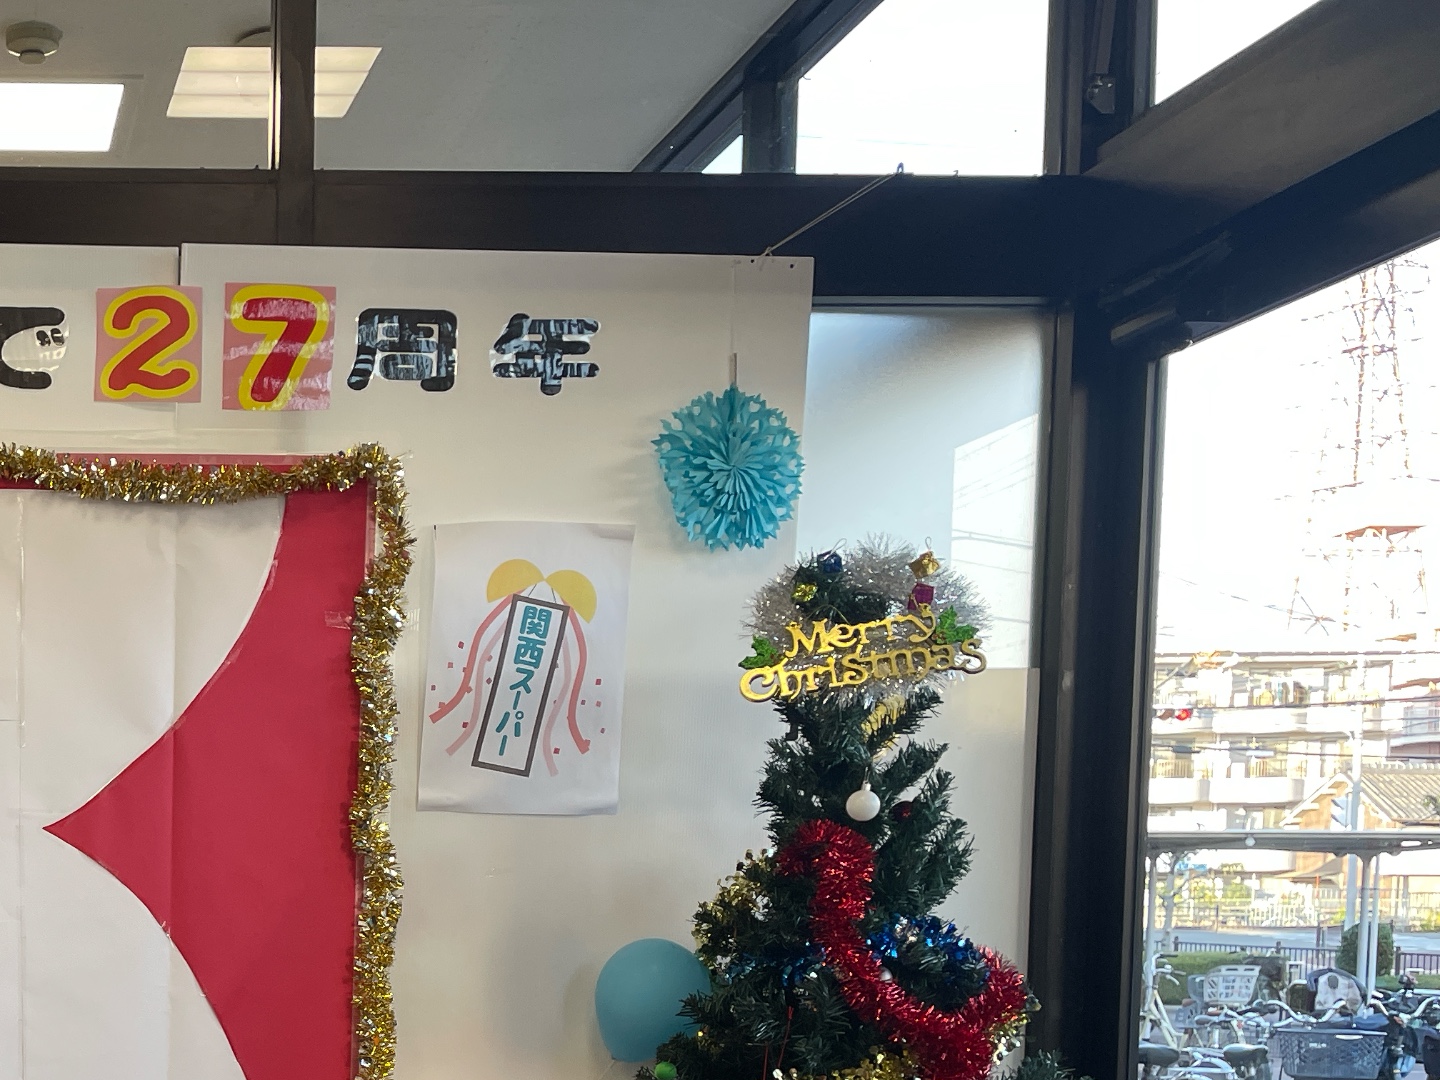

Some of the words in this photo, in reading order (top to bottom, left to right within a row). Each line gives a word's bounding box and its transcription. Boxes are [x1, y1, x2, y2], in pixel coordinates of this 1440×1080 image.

[784, 602, 937, 658] Merry
[496, 605, 552, 757] 関西スーパー
[739, 638, 987, 703] Christmas
